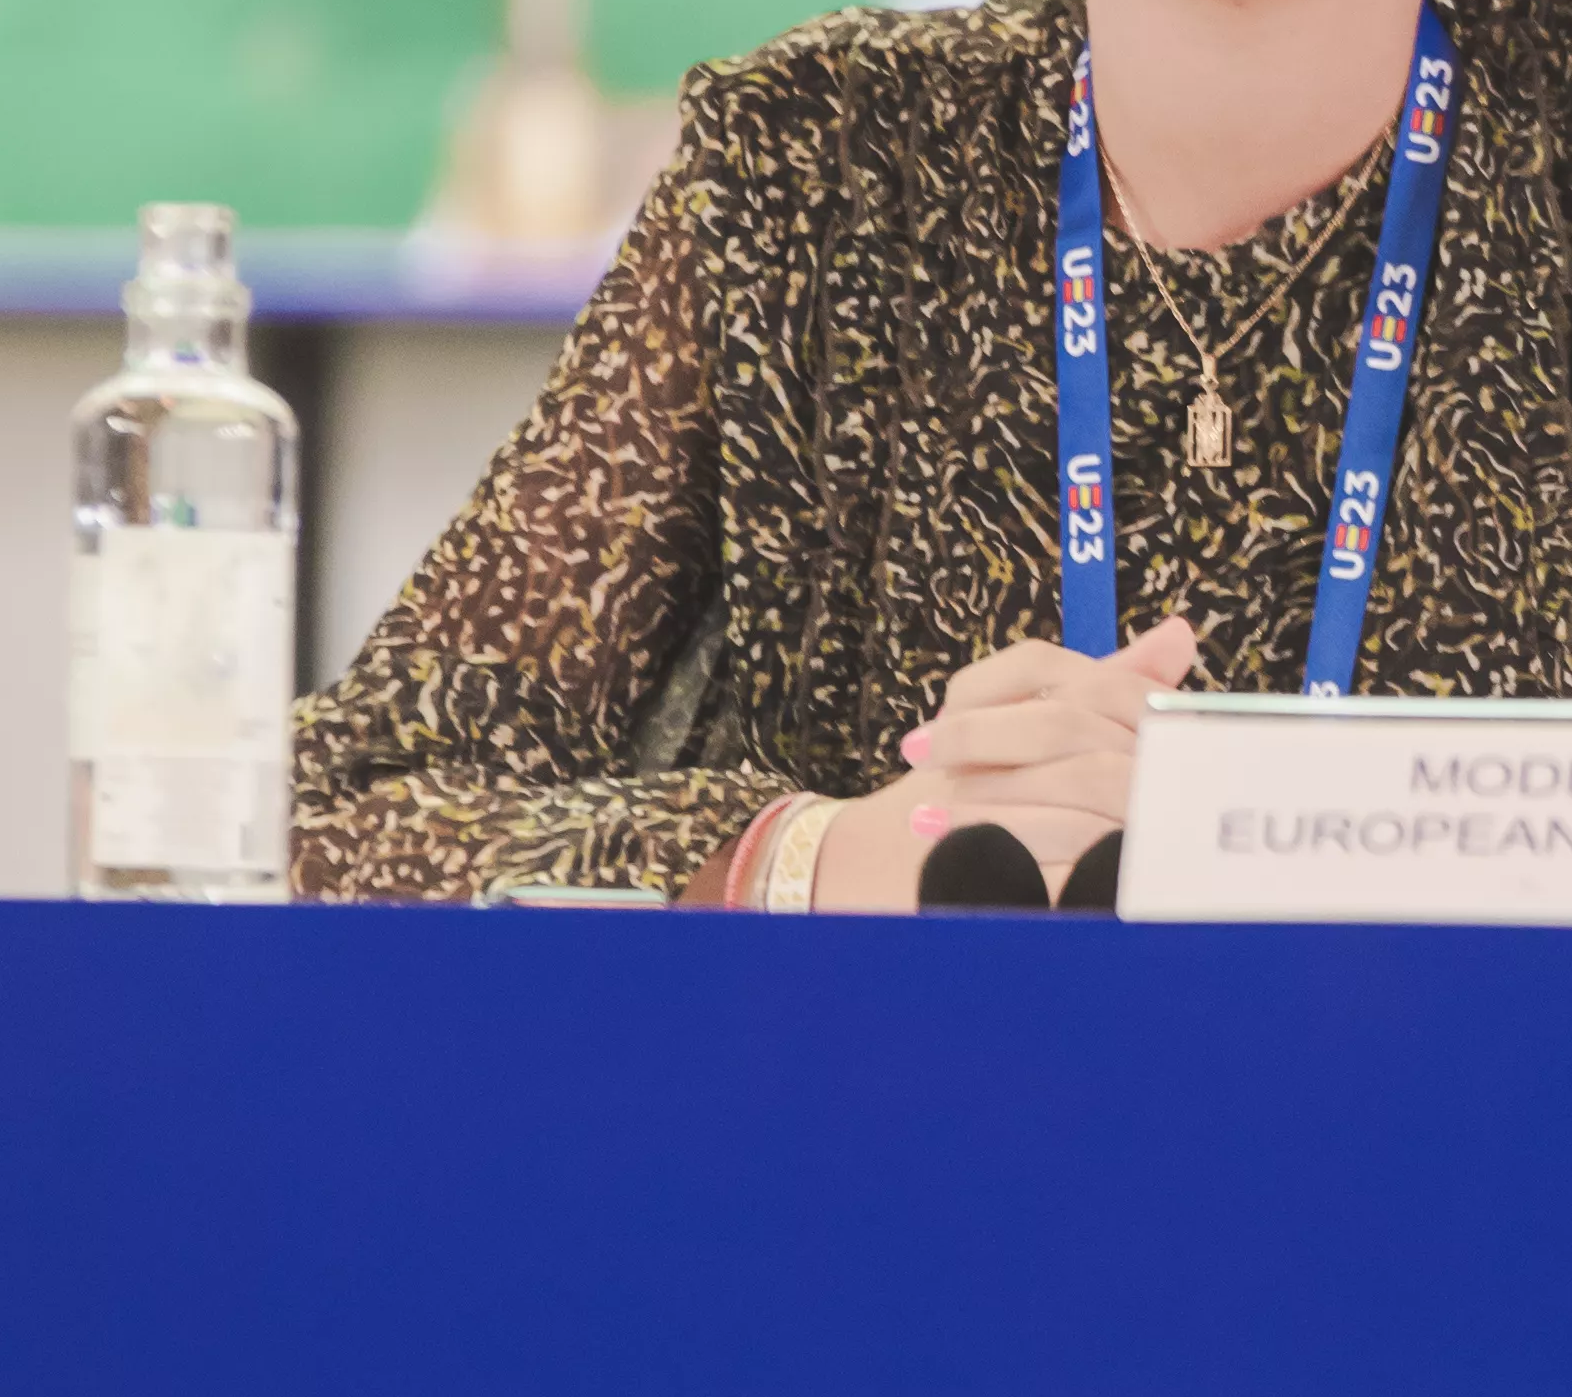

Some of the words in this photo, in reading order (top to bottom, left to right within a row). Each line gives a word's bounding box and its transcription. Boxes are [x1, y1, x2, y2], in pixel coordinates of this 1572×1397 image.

[1404, 56, 1454, 165] UE23
[1061, 246, 1098, 358] UE23
[1365, 261, 1418, 372] UE23
[1066, 453, 1105, 565] UE23
[1329, 469, 1381, 582] UE23
